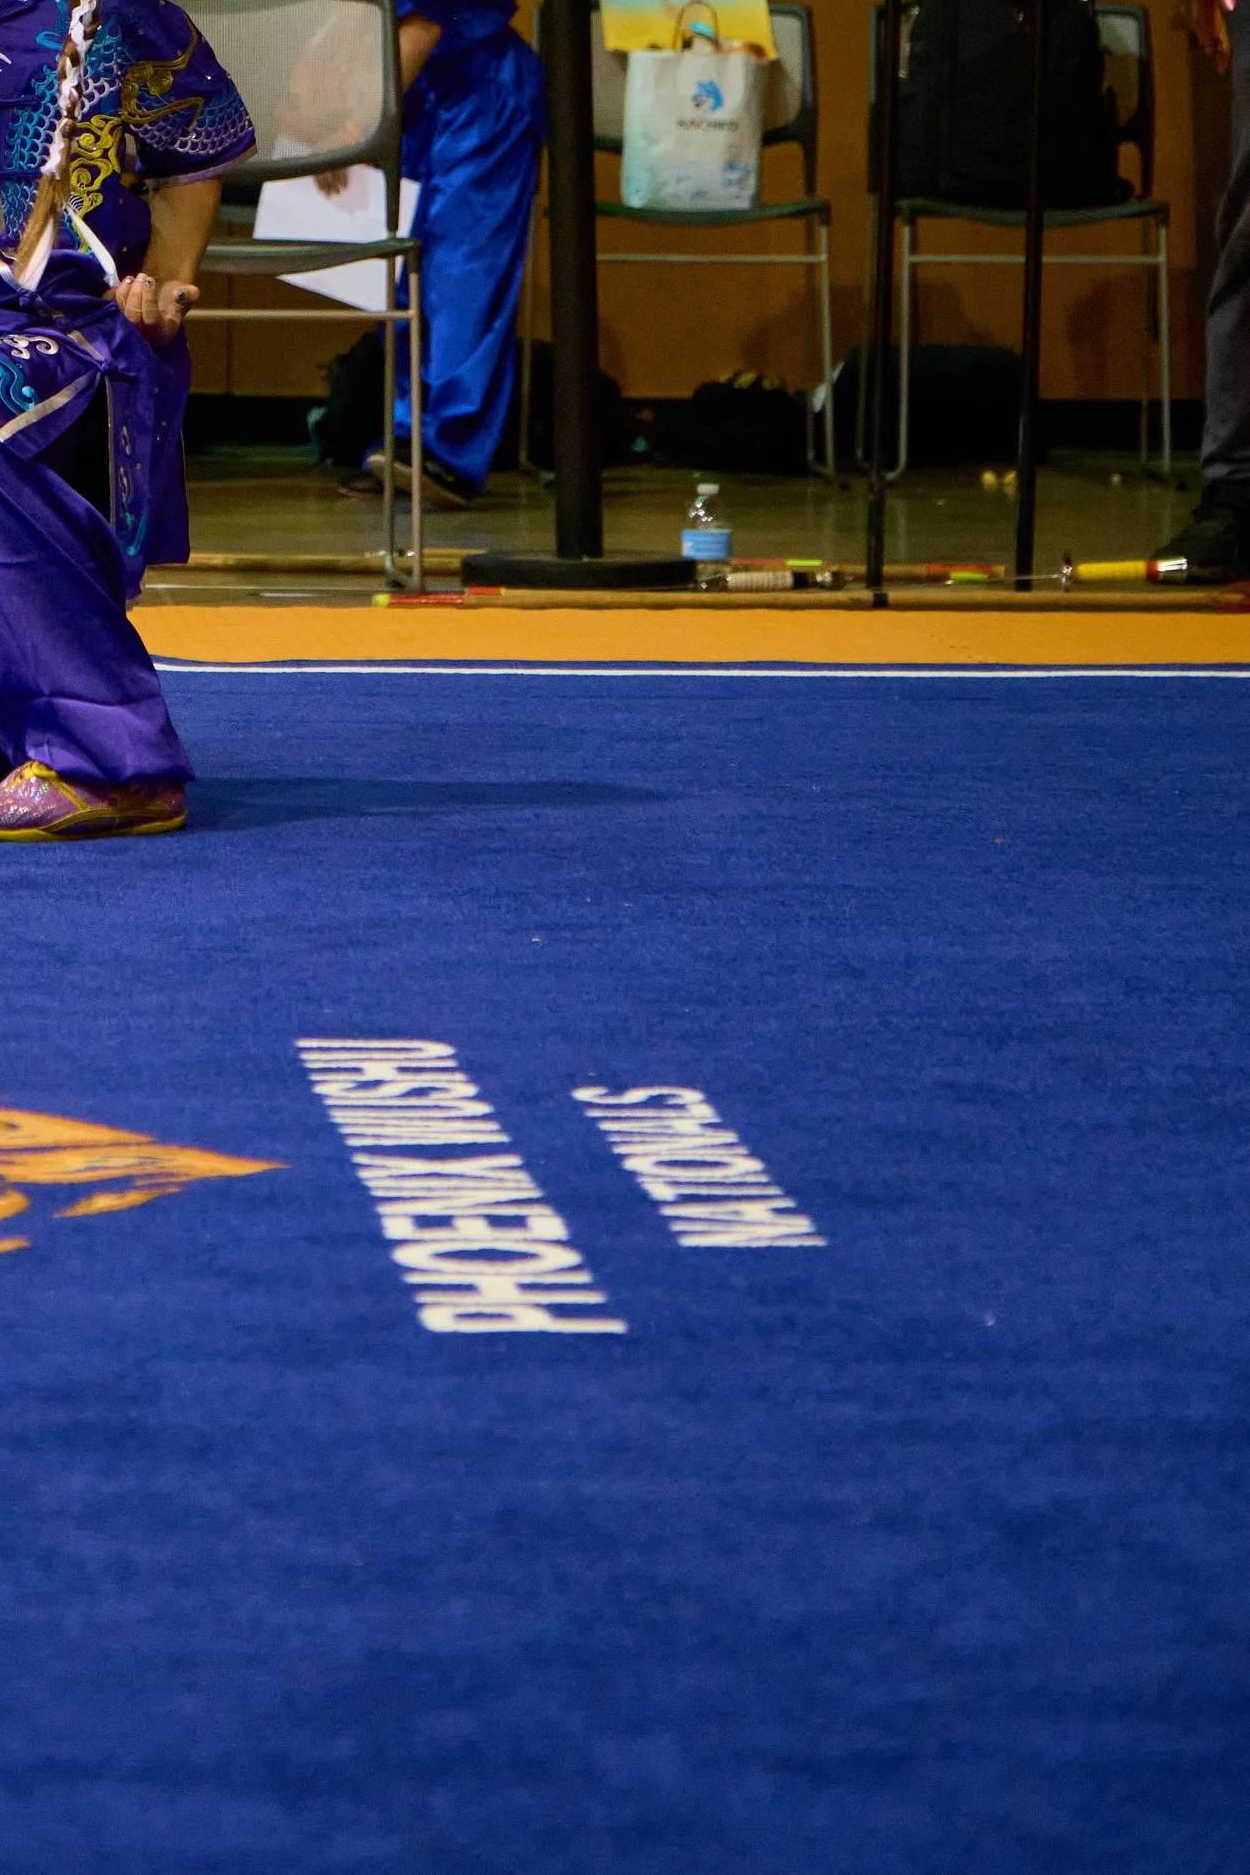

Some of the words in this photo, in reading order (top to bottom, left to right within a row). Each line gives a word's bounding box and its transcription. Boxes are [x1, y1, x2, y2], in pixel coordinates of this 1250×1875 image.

[293, 1037, 512, 1147] WUSHU
[570, 1085, 830, 1248] NATIONALS
[350, 1151, 630, 1335] PHOENIX
